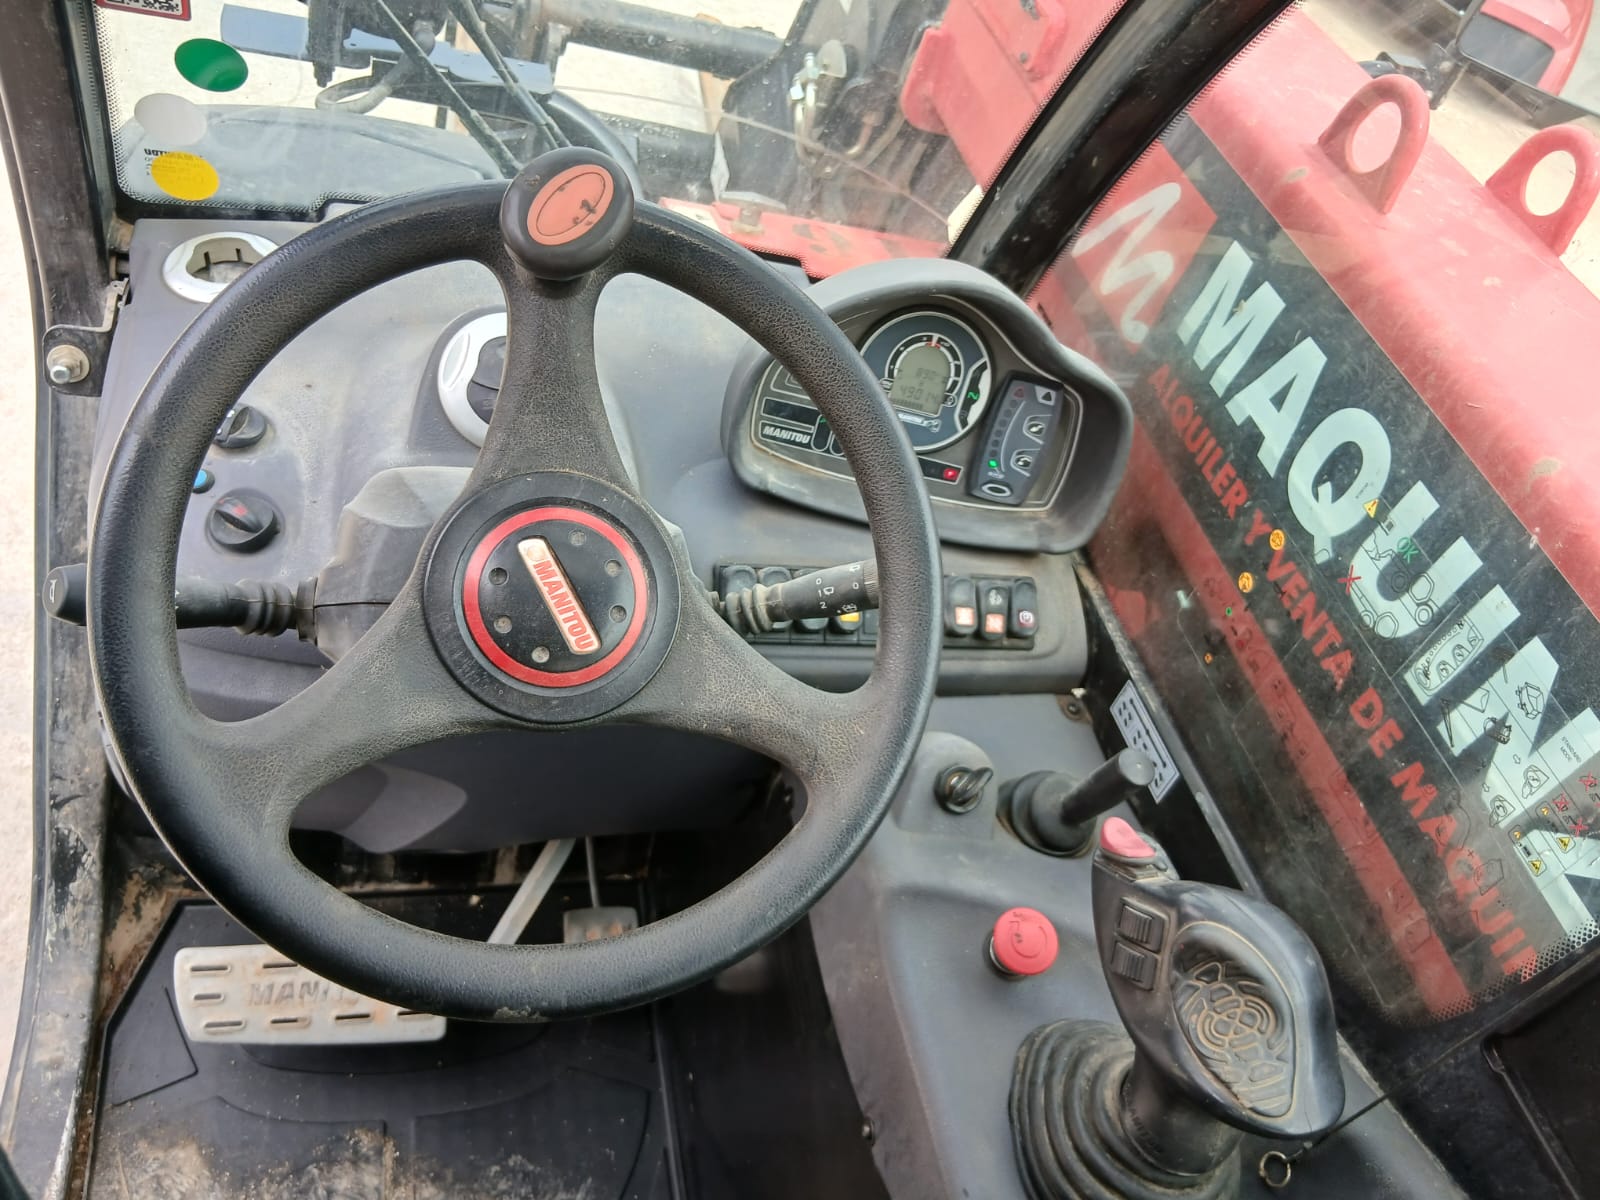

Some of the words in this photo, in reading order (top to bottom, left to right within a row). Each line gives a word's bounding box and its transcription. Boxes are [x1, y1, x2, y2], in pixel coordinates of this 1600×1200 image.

[762, 425, 812, 444] MANITOU
[1147, 364, 1249, 519] ALQUILER
[1244, 508, 1273, 546] Y
[1266, 549, 1355, 693] VENTA
[1348, 686, 1404, 759] DE
[1397, 536, 1419, 564] OK
[532, 558, 595, 651] MANITOU
